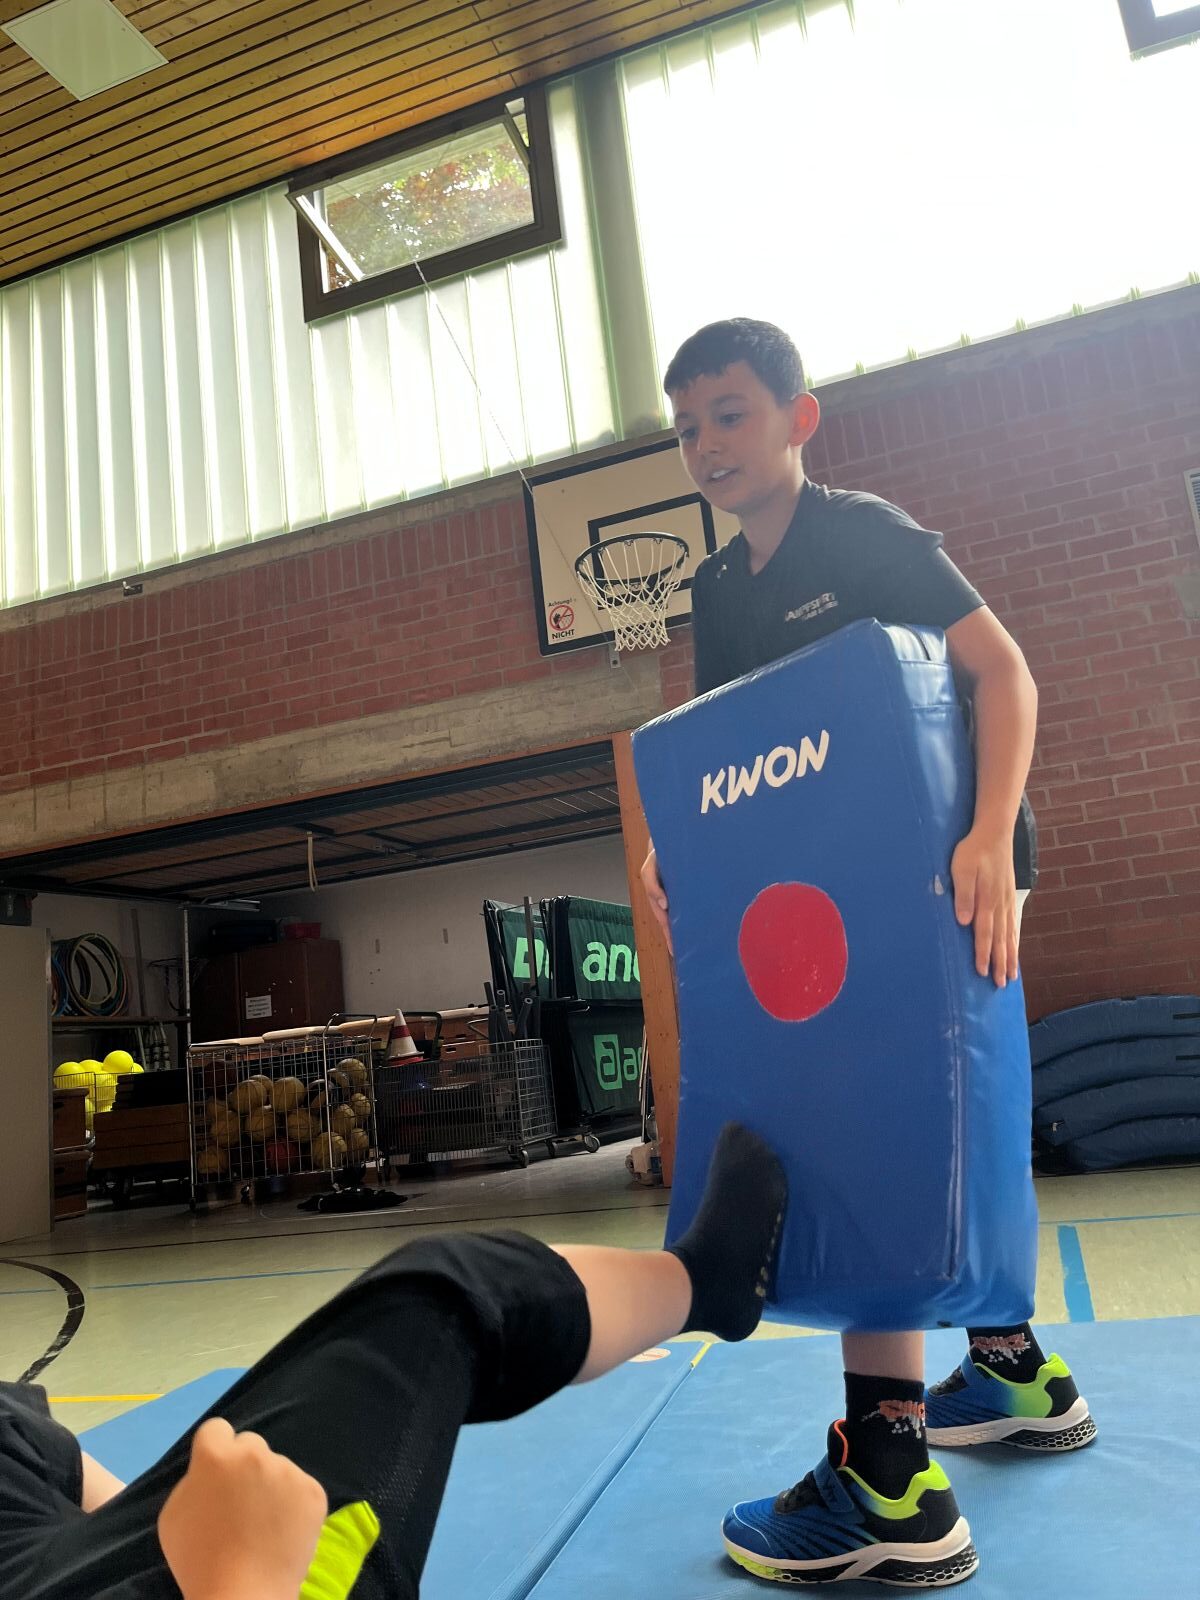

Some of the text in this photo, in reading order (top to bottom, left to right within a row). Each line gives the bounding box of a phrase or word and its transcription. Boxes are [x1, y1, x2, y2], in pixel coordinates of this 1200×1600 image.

[551, 629, 575, 639] NICHT
[700, 729, 830, 814] KWON
[582, 941, 641, 982] an
